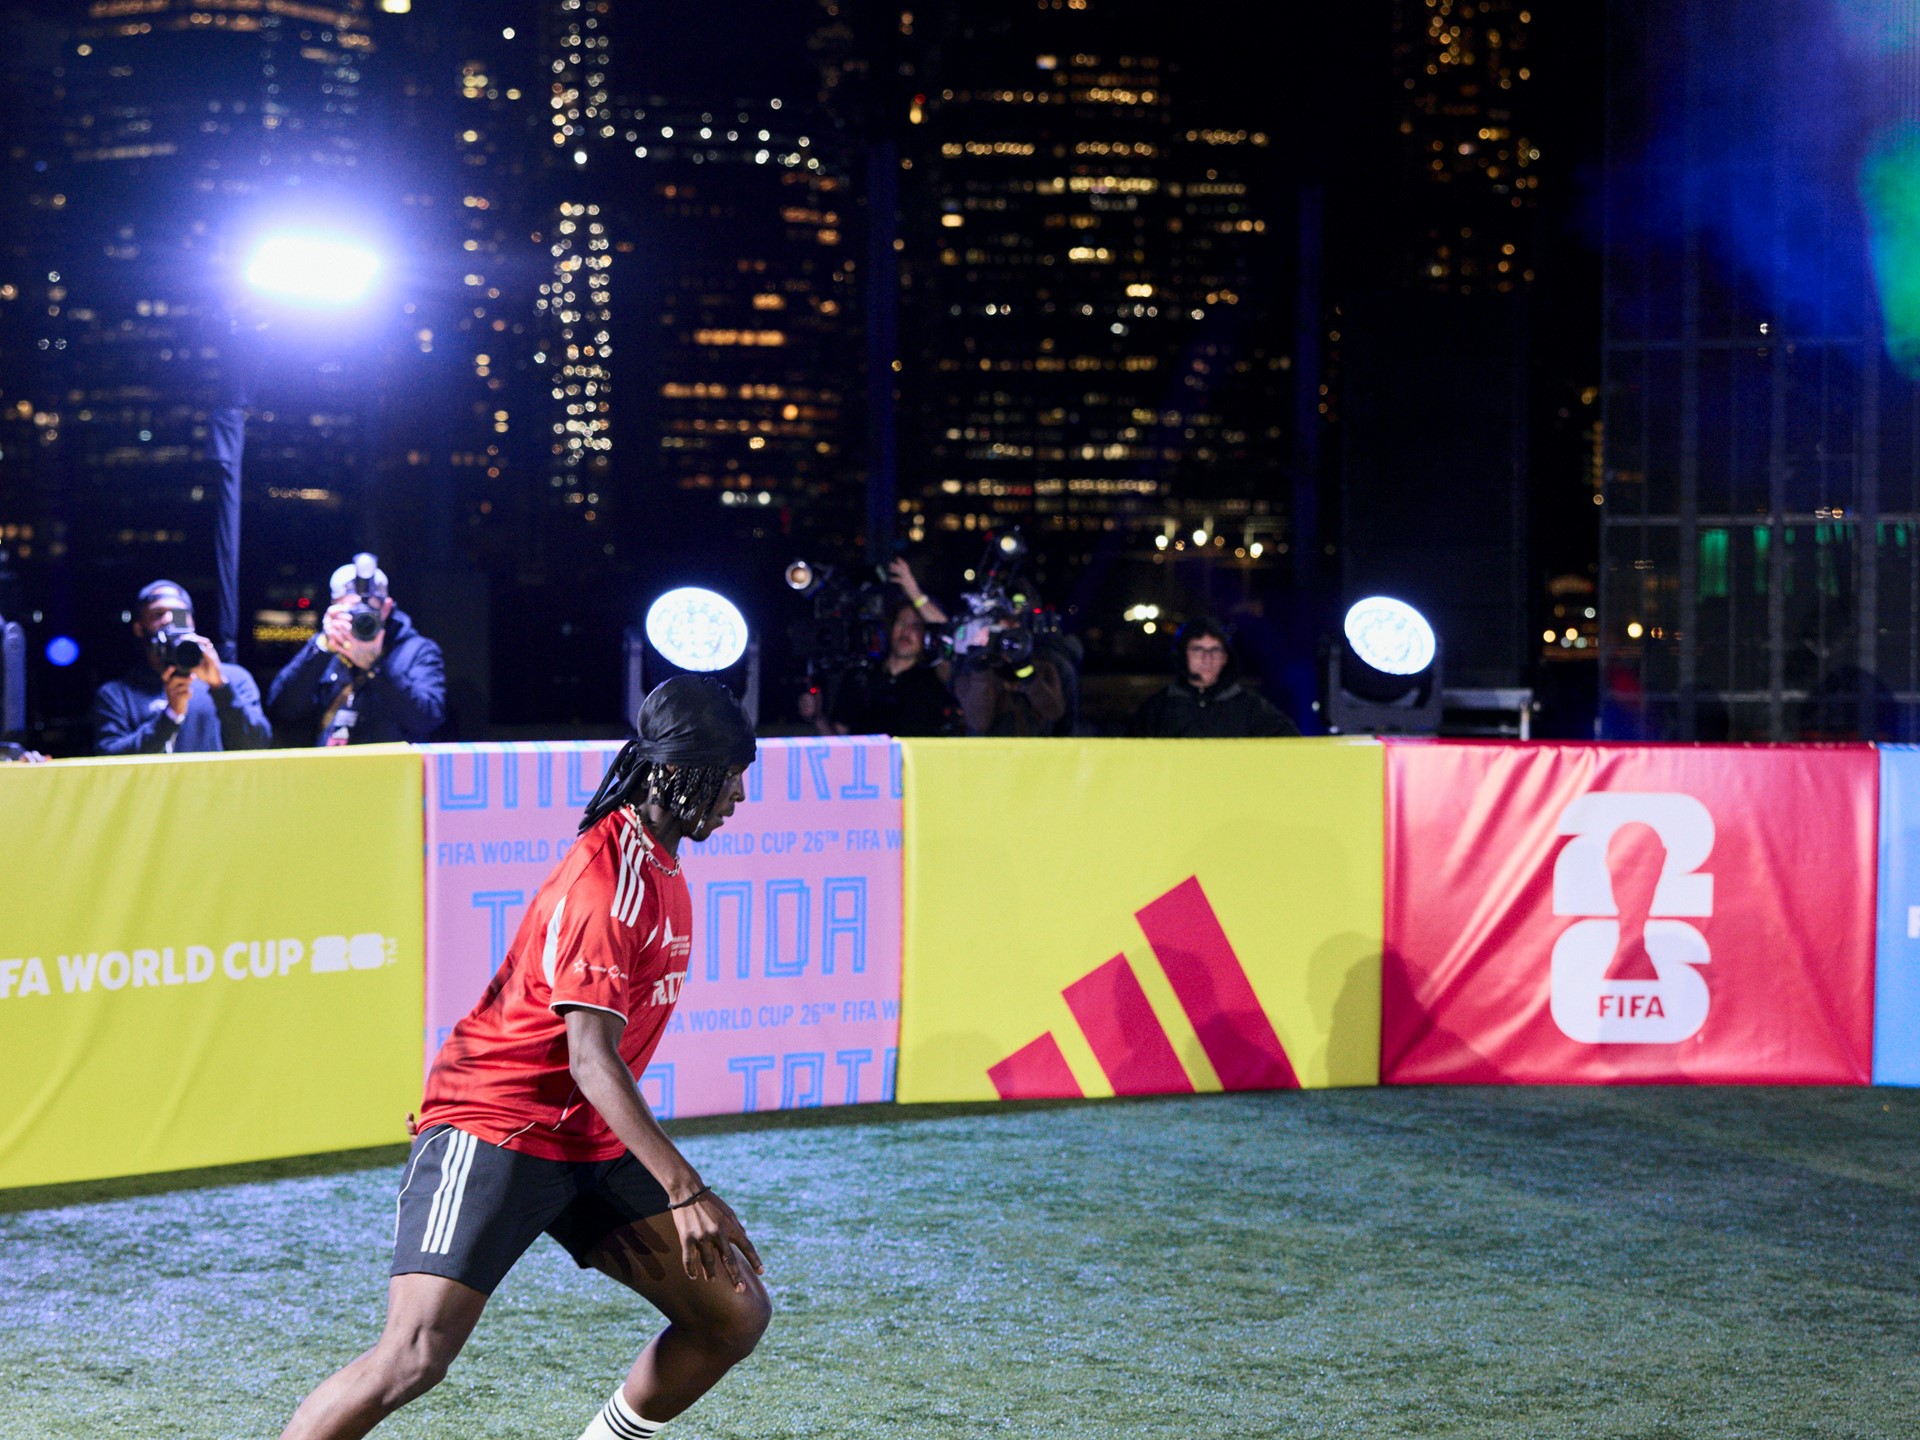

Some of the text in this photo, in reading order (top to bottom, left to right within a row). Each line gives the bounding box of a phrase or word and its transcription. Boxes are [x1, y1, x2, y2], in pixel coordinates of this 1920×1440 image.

[438, 841, 477, 865] FIFA
[481, 838, 550, 864] WORLD
[761, 831, 798, 854] CUP
[846, 829, 880, 851] FIFA
[57, 944, 216, 993] WORLD
[222, 938, 304, 981] CUP
[689, 1008, 753, 1032] WORLD
[758, 1005, 795, 1028] CUP
[842, 1000, 878, 1023] FIFA
[1597, 995, 1666, 1019] FIFA
